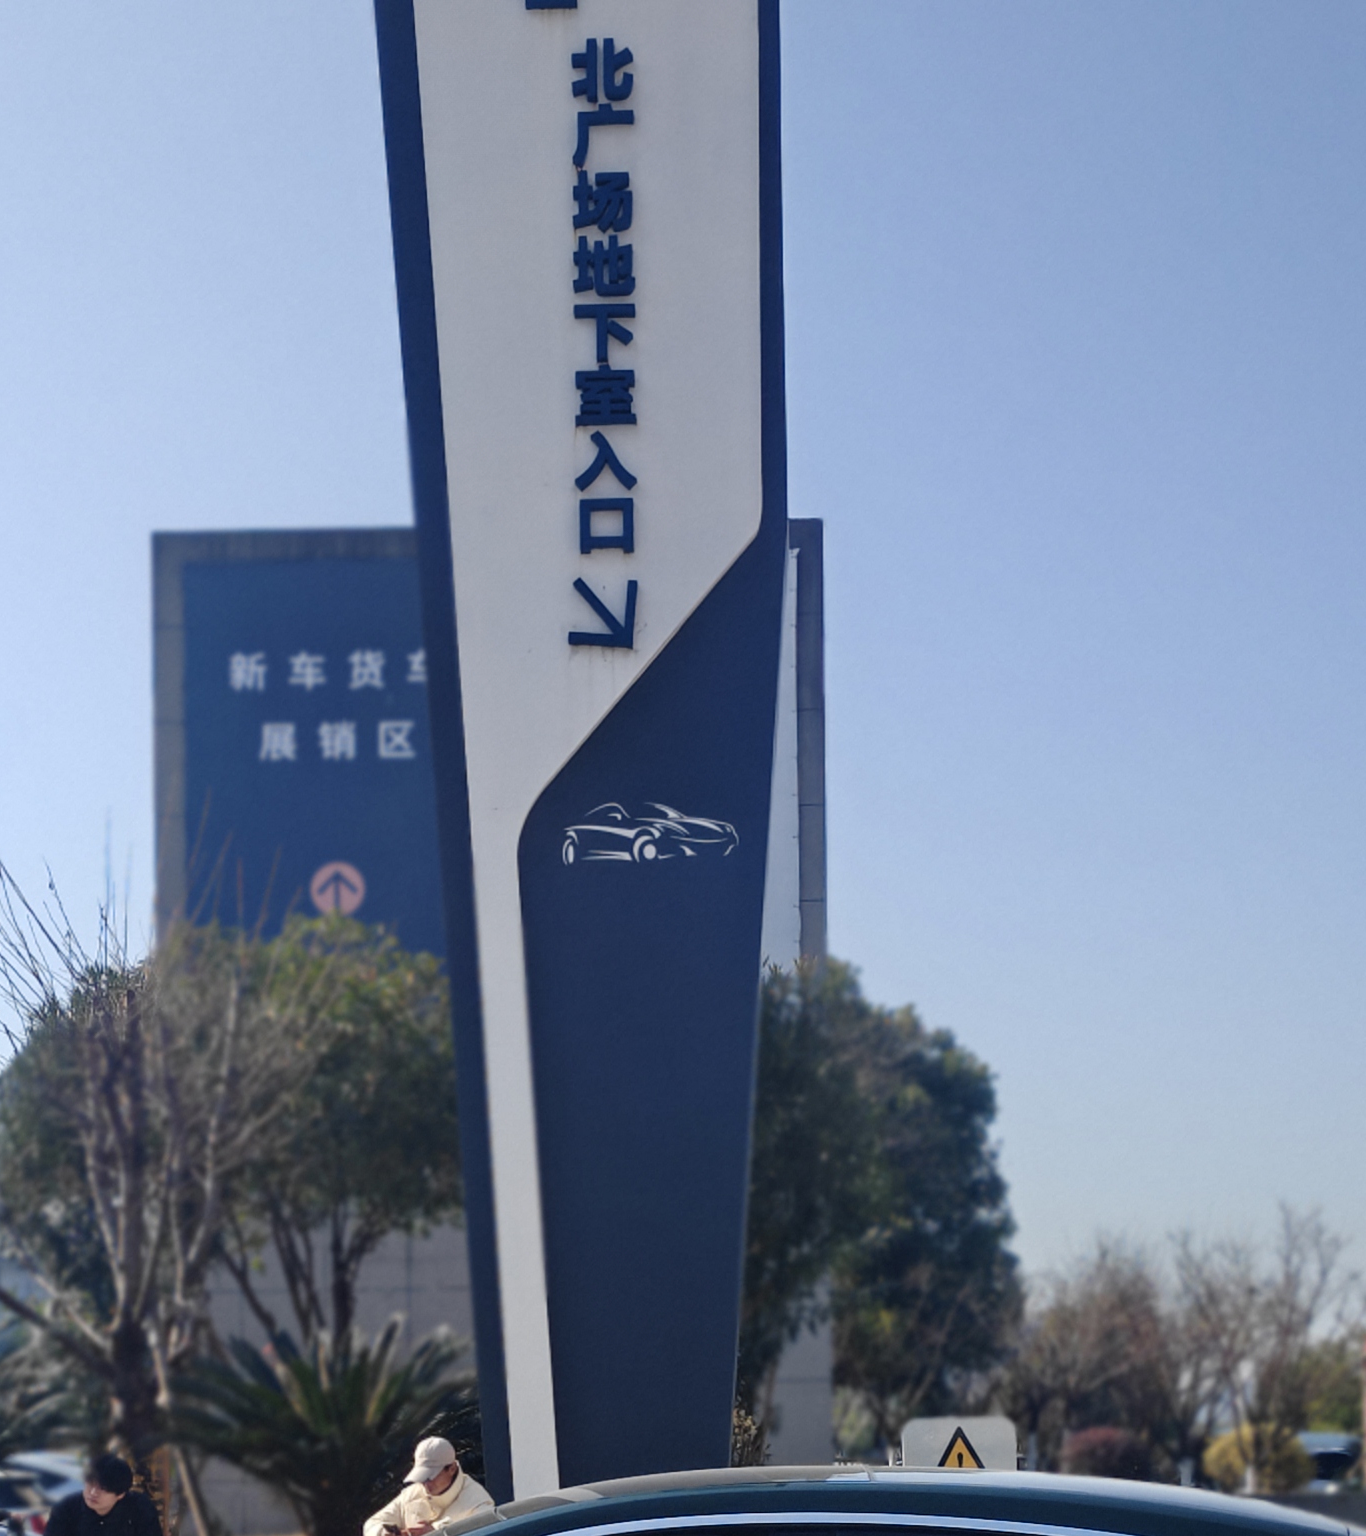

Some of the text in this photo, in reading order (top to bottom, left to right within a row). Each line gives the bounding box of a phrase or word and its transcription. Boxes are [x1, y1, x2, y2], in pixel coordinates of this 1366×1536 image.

[571, 37, 637, 555] 北广场地下室入口
[259, 720, 416, 761] 展销区
